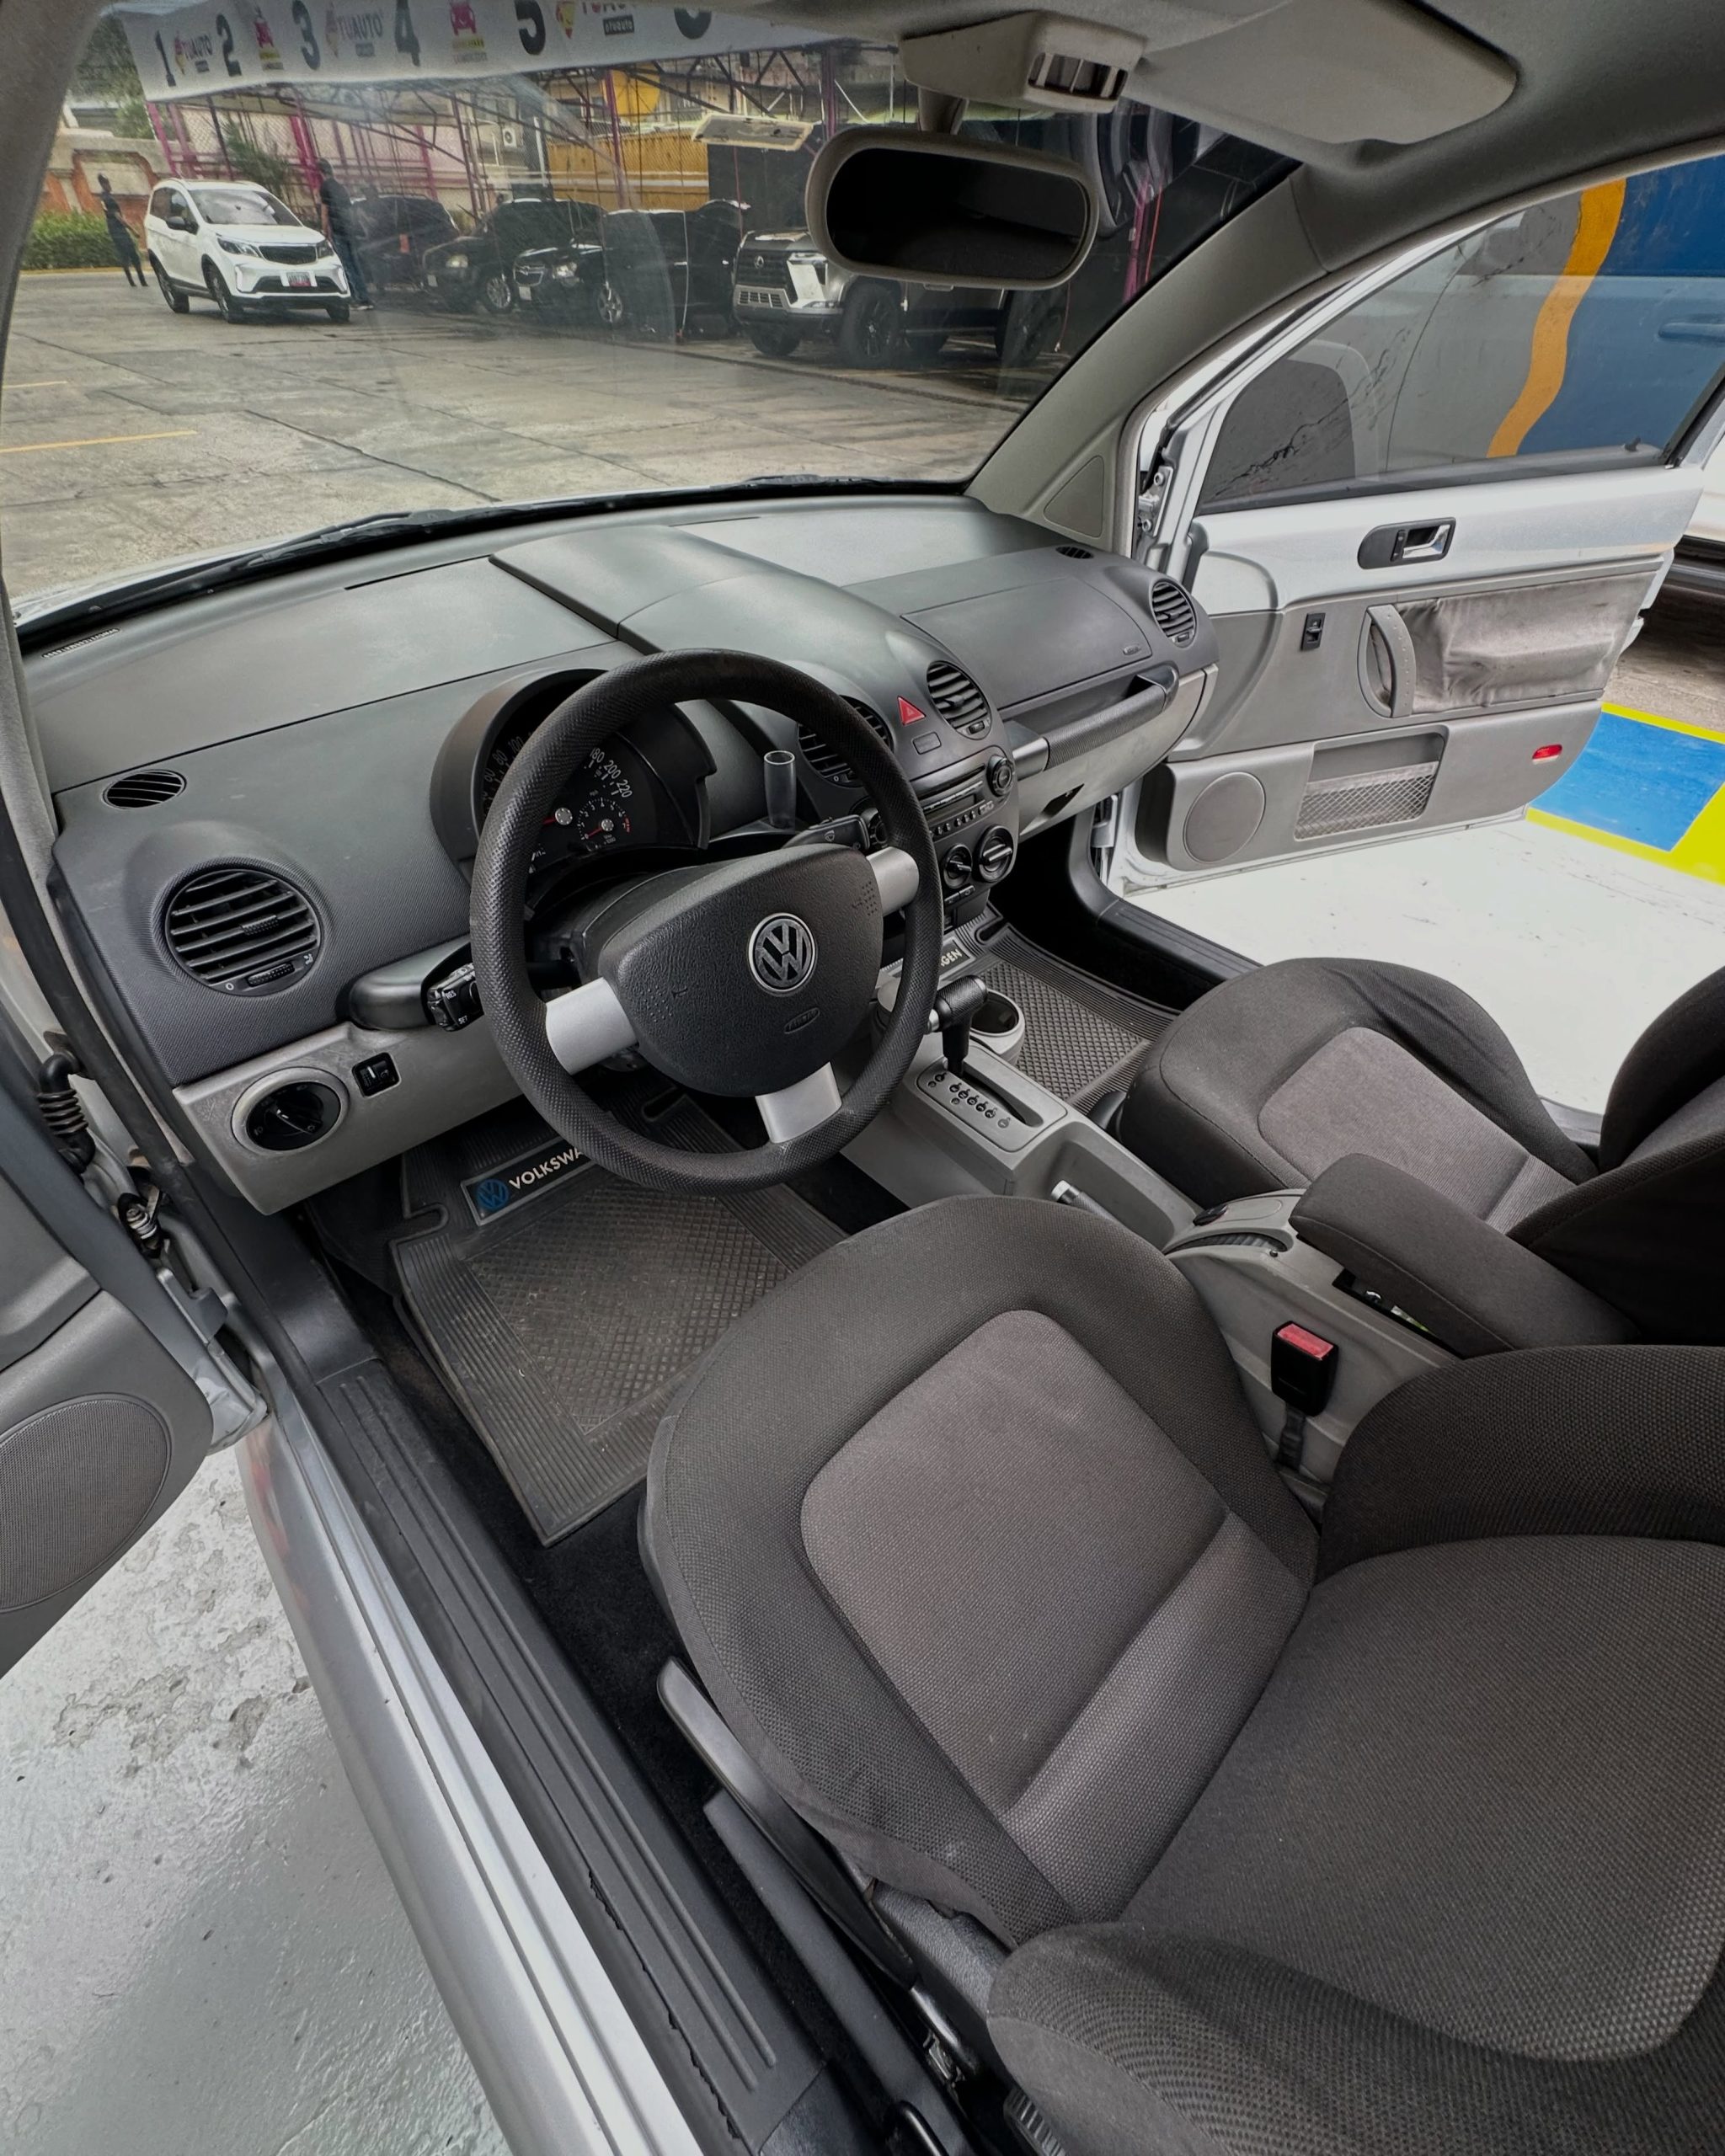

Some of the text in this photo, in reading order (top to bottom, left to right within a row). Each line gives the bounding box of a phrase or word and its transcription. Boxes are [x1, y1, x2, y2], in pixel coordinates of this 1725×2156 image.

[155, 30, 176, 87] 1
[216, 13, 242, 77] 2
[292, 0, 321, 71] 3
[394, 0, 420, 67] 4
[603, 760, 622, 780] 200
[616, 779, 633, 798] 220
[940, 948, 963, 968] GEN
[457, 1014, 468, 1025] SET
